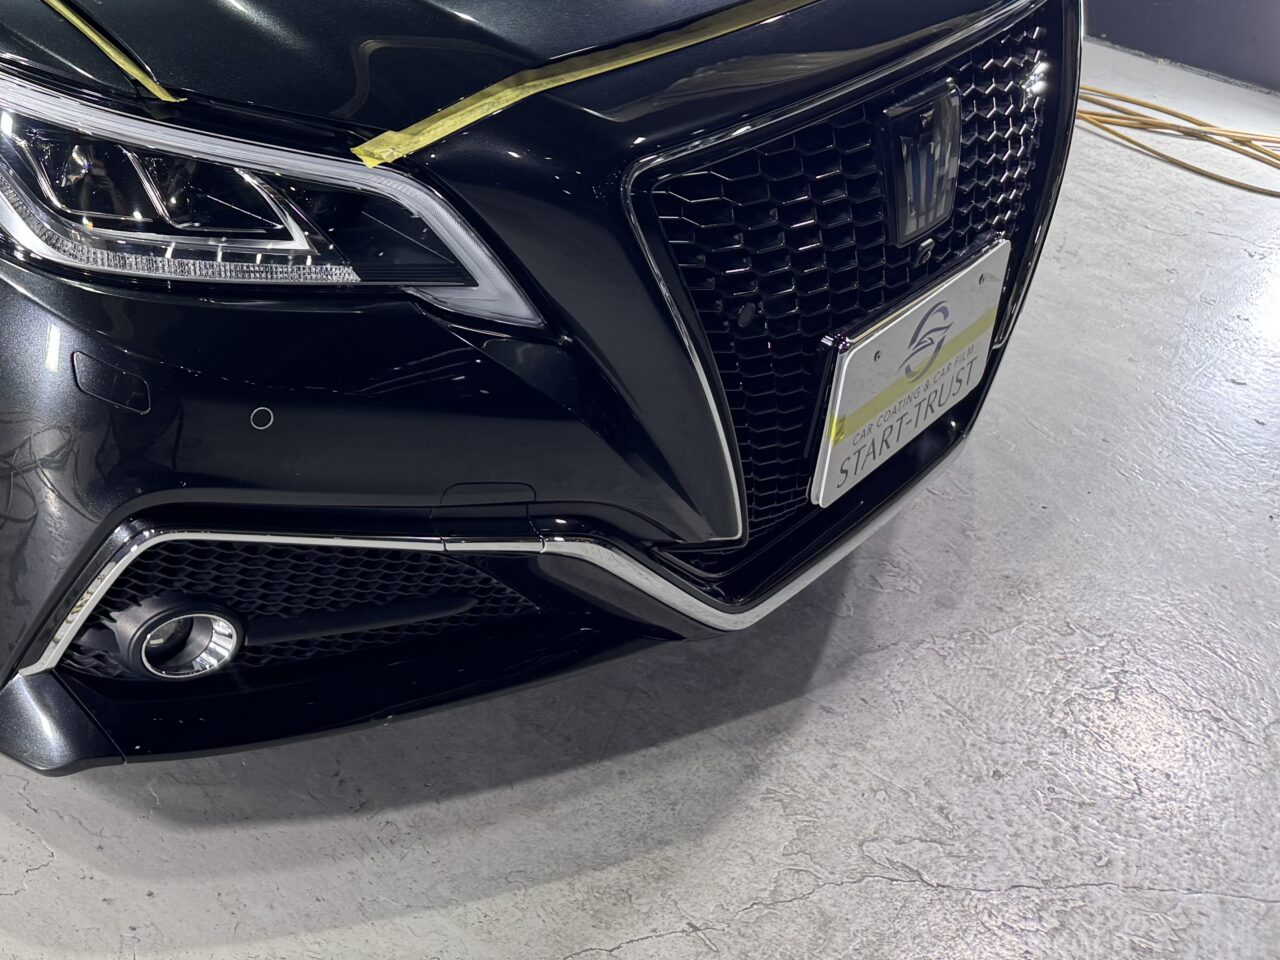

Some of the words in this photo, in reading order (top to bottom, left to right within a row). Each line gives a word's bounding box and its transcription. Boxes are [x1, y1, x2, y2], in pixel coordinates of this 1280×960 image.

[836, 355, 979, 489] START-TRUST
[852, 423, 874, 446] CAR
[876, 386, 921, 428] COATING
[923, 379, 931, 392] &
[933, 362, 952, 384] CAR
[954, 343, 975, 366] FILM
